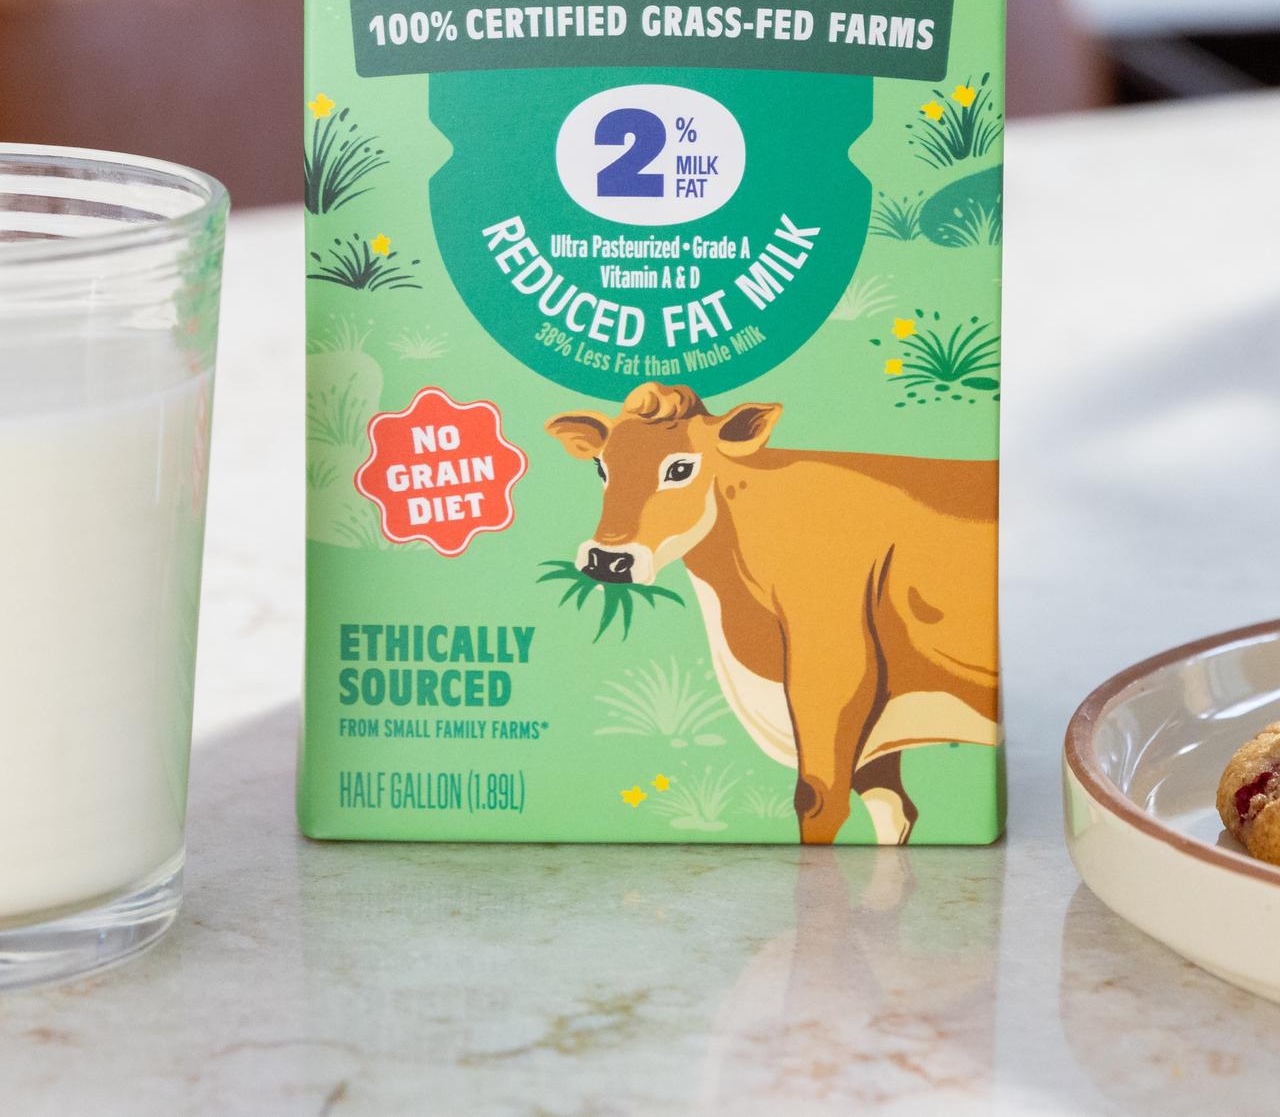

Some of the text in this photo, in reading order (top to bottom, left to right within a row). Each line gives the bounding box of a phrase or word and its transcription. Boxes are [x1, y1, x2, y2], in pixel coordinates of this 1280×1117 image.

[368, 4, 936, 51] 100% CERTIFIED GRASS-FED FARMS
[675, 155, 719, 176] MILK
[675, 178, 708, 199] FAT
[550, 234, 751, 259] Ultra Pasteurized Grade A
[481, 213, 821, 347] REDUCED FAT MILK
[600, 265, 701, 289] Vitamin A & D
[534, 322, 767, 377] 38% Less Fat than Whole Milk
[410, 424, 460, 454] NO
[385, 455, 495, 493] GRAIN
[406, 491, 486, 526] DIET
[340, 623, 536, 664] ETHICALLY
[339, 667, 512, 707] SOURCED
[339, 718, 380, 738] FROM
[384, 719, 431, 739] SMALL
[435, 720, 487, 740] FAMILY
[339, 769, 526, 814] HALF GALLON (1.89L)
